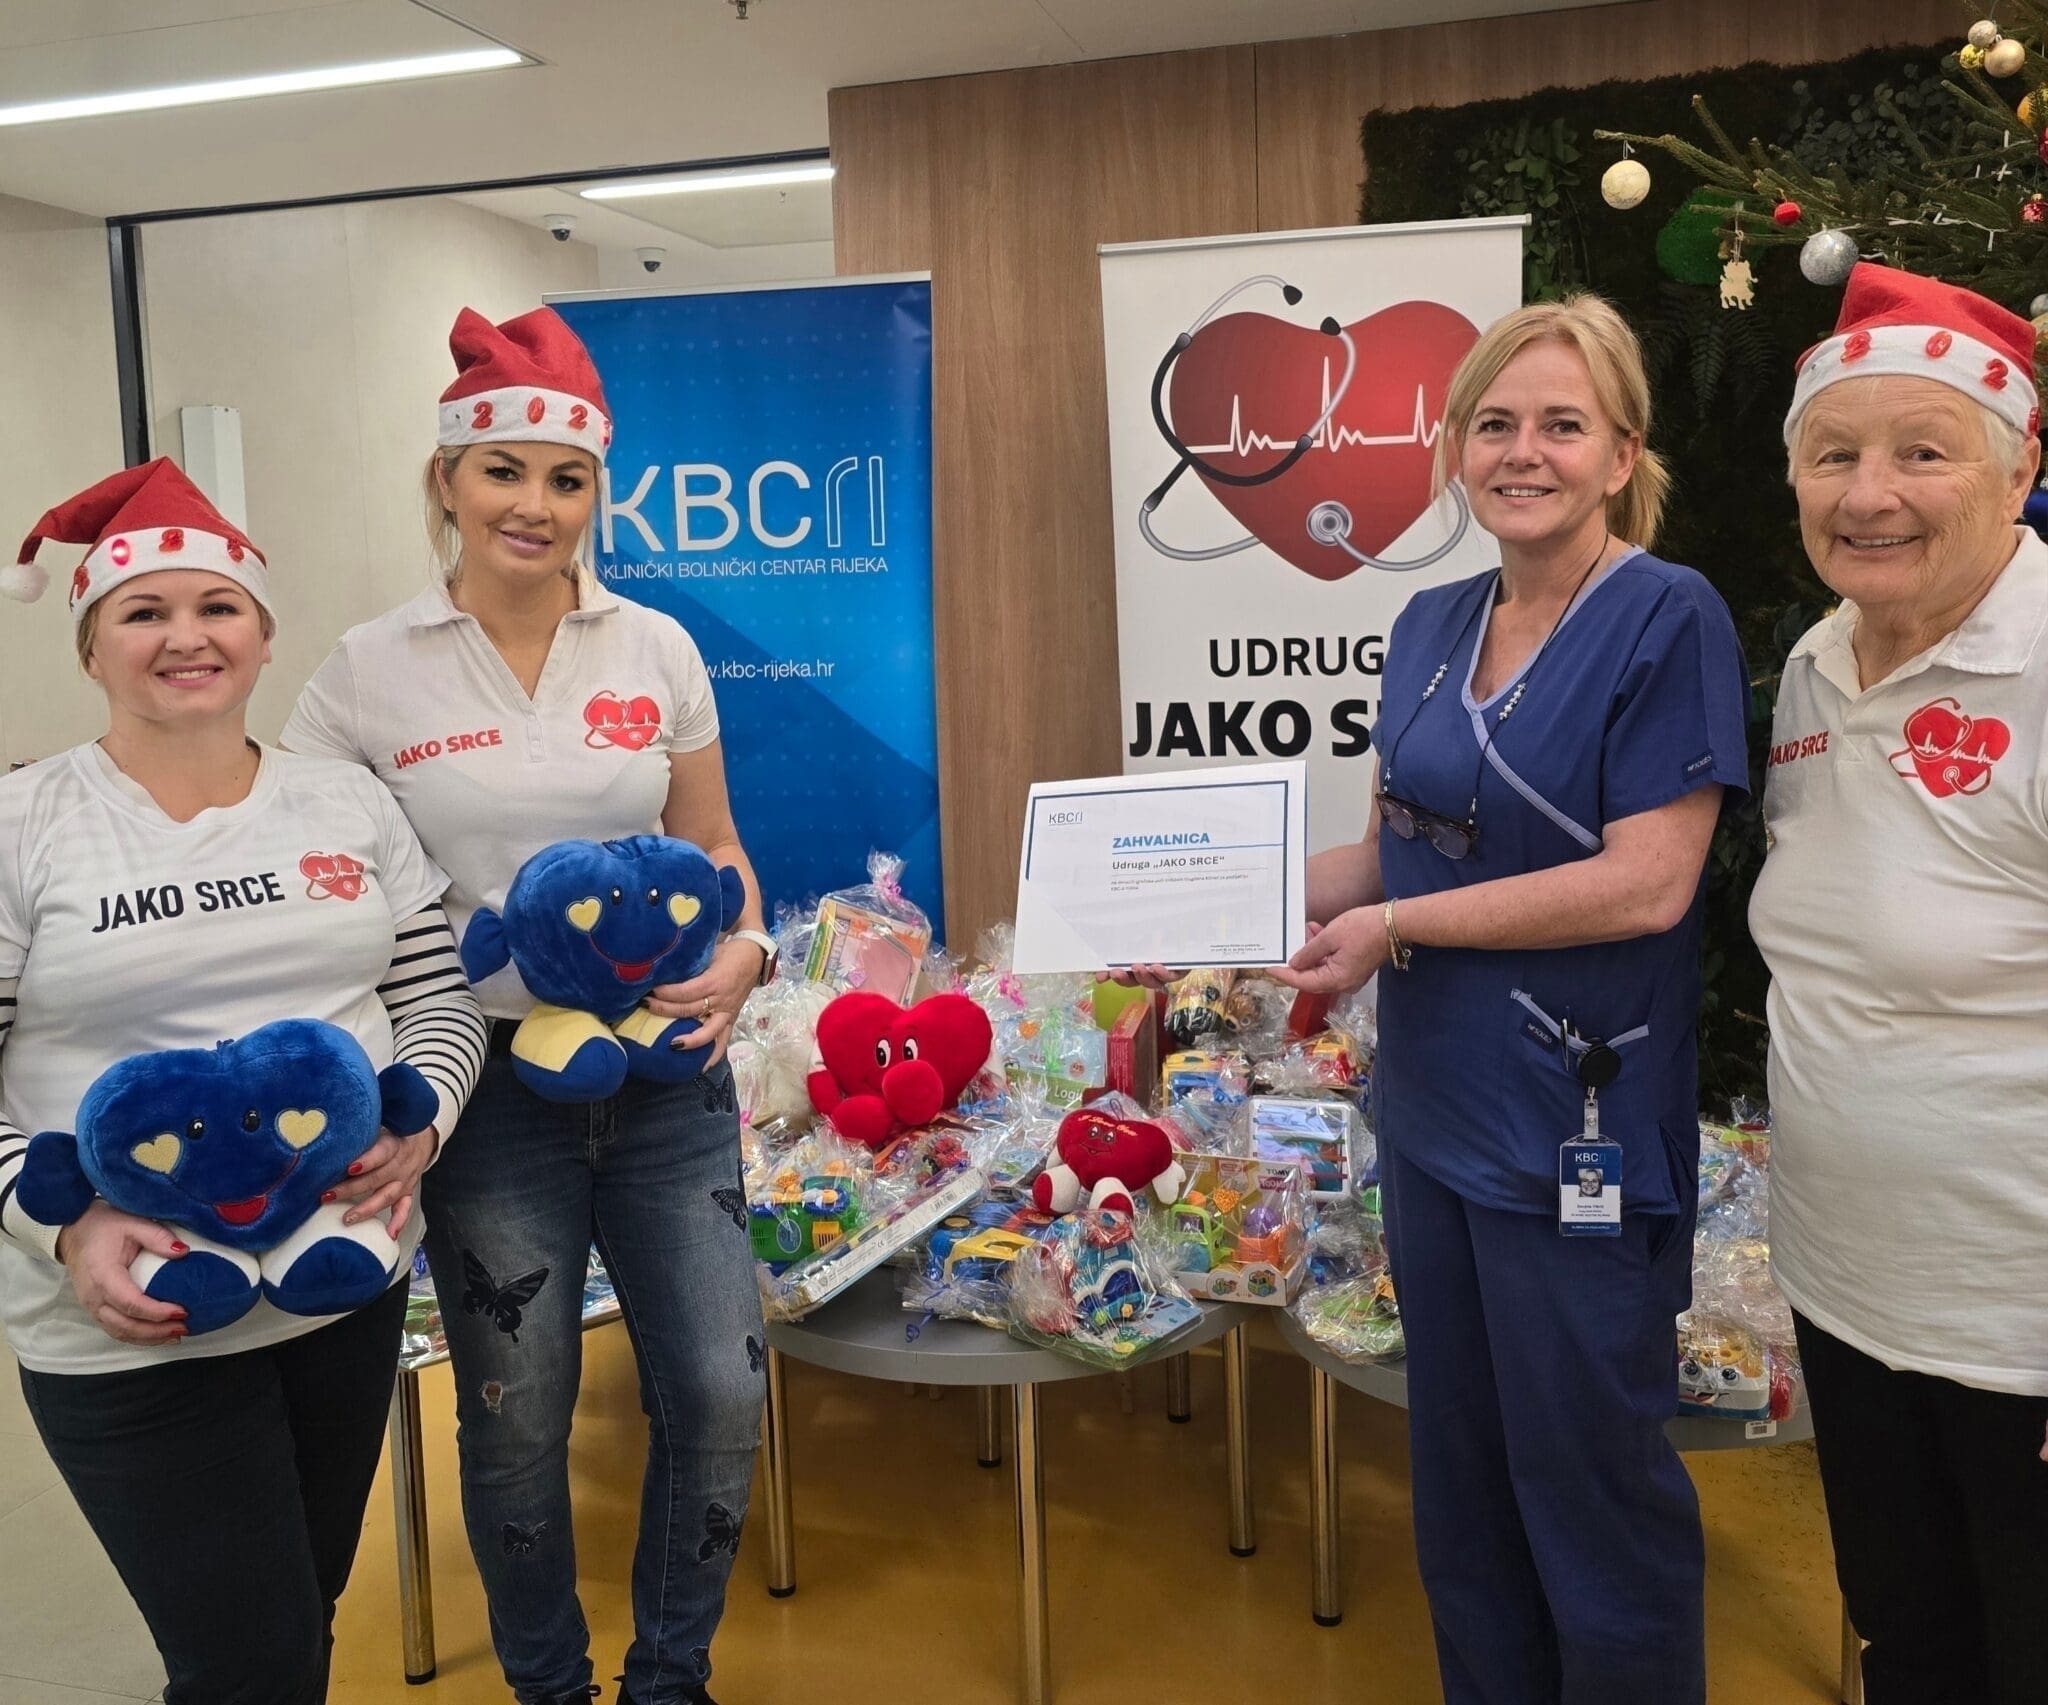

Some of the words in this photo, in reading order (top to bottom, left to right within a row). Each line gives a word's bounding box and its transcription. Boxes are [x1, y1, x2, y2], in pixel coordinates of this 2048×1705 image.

[604, 560, 673, 580] KLINIČKI
[679, 558, 756, 578] BOLNIČKI
[761, 559, 826, 576] CENTAR
[832, 557, 888, 574] RIJEKA
[1129, 699, 1312, 758] JAKO
[1330, 699, 1382, 758] S
[393, 740, 442, 769] JAKO
[446, 729, 502, 753] SRCE
[1768, 740, 1800, 768] JAKO
[1800, 731, 1829, 759] SRCE
[1112, 832, 1211, 849] ZAHVALNICA
[1112, 860, 1150, 871] Udruga
[91, 884, 185, 933] JAKO
[195, 872, 286, 912] SRCE
